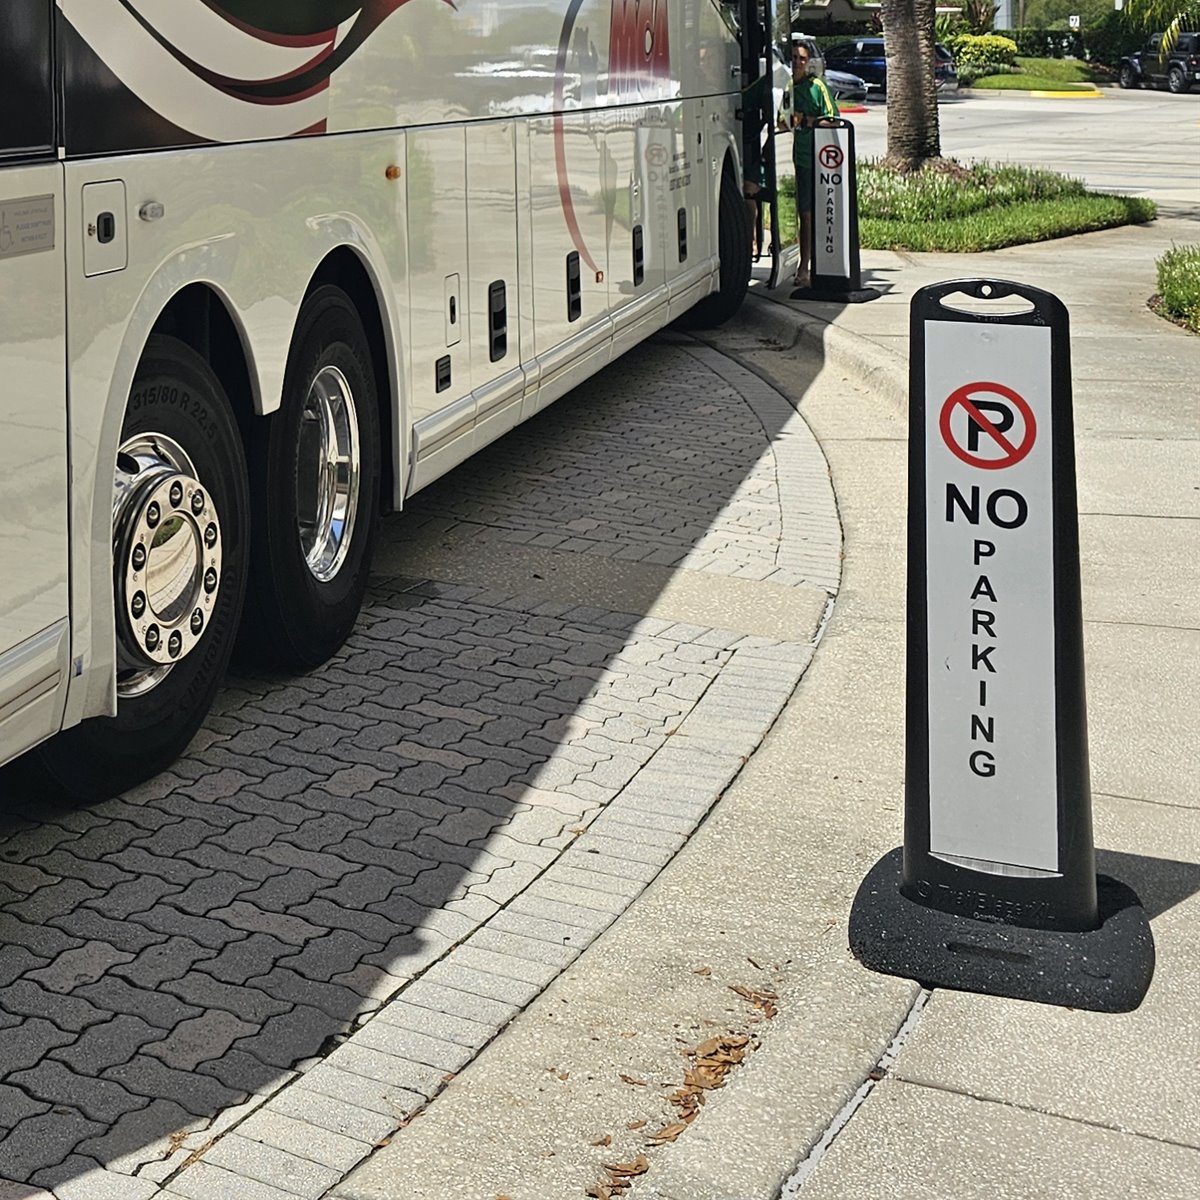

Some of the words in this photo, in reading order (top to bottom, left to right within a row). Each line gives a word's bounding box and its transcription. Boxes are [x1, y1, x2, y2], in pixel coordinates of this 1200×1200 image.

[820, 172, 843, 186] NO
[825, 187, 835, 254] PARKING
[133, 385, 178, 411] 315/80
[179, 391, 191, 412] R
[189, 401, 218, 439] 22.5
[945, 482, 1029, 530] NO
[968, 538, 999, 778] PARKING
